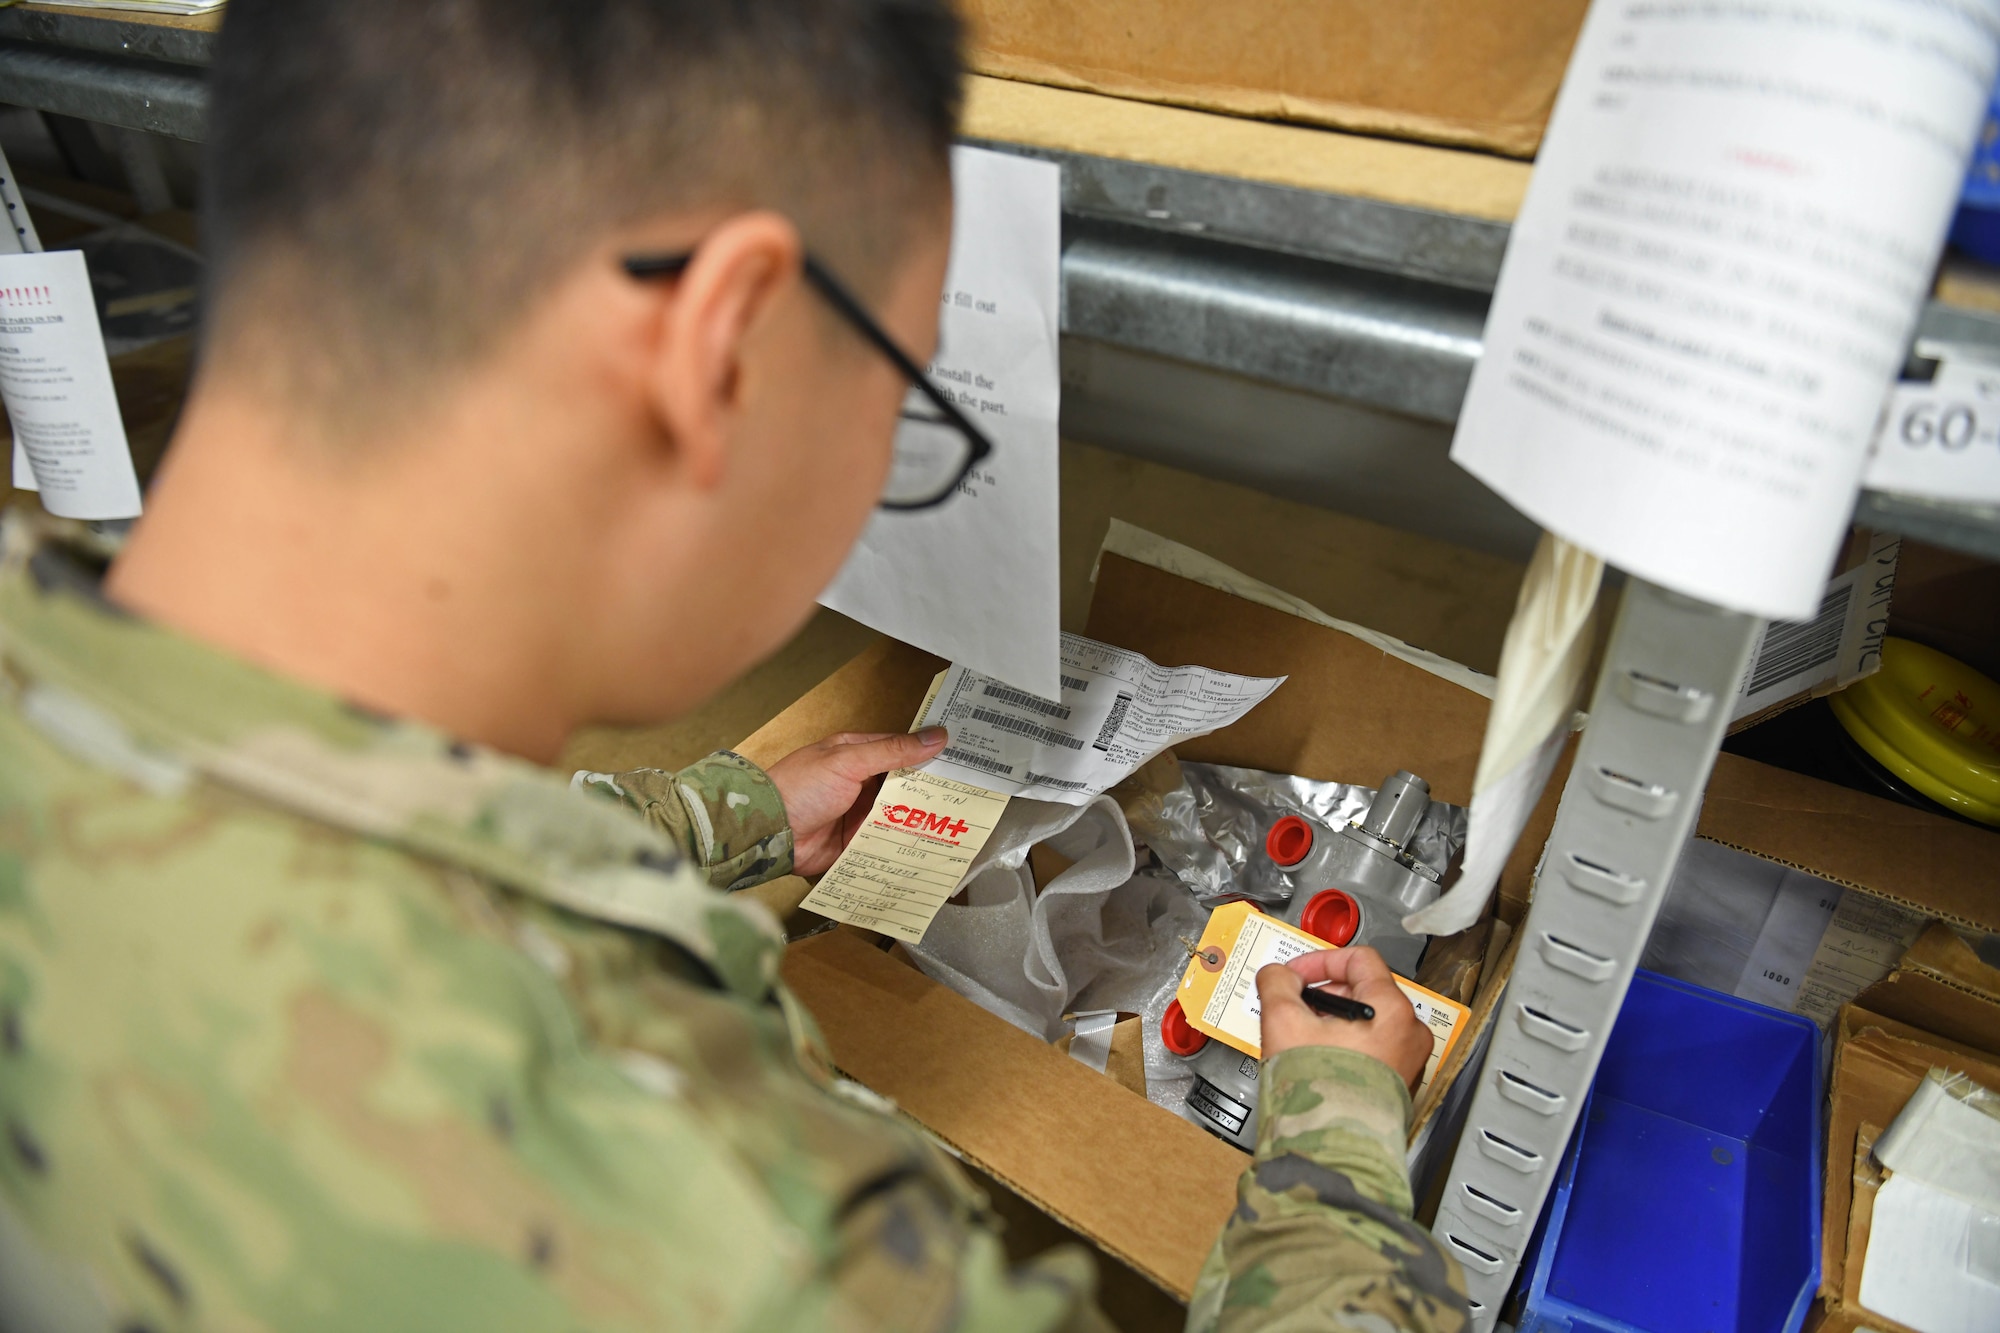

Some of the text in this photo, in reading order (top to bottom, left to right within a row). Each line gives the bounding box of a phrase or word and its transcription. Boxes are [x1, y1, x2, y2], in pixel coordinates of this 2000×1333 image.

[954, 291, 973, 309] fill
[975, 300, 997, 315] out
[935, 362, 972, 386] install
[975, 373, 994, 391] the
[959, 391, 978, 408] the
[980, 399, 1008, 417] part.
[983, 469, 996, 486] in
[1104, 757, 1128, 766] AIRLIFT
[882, 804, 969, 838] CBM+
[896, 846, 927, 860] 115678
[848, 914, 878, 926] 115678
[1278, 947, 1292, 958] 5542
